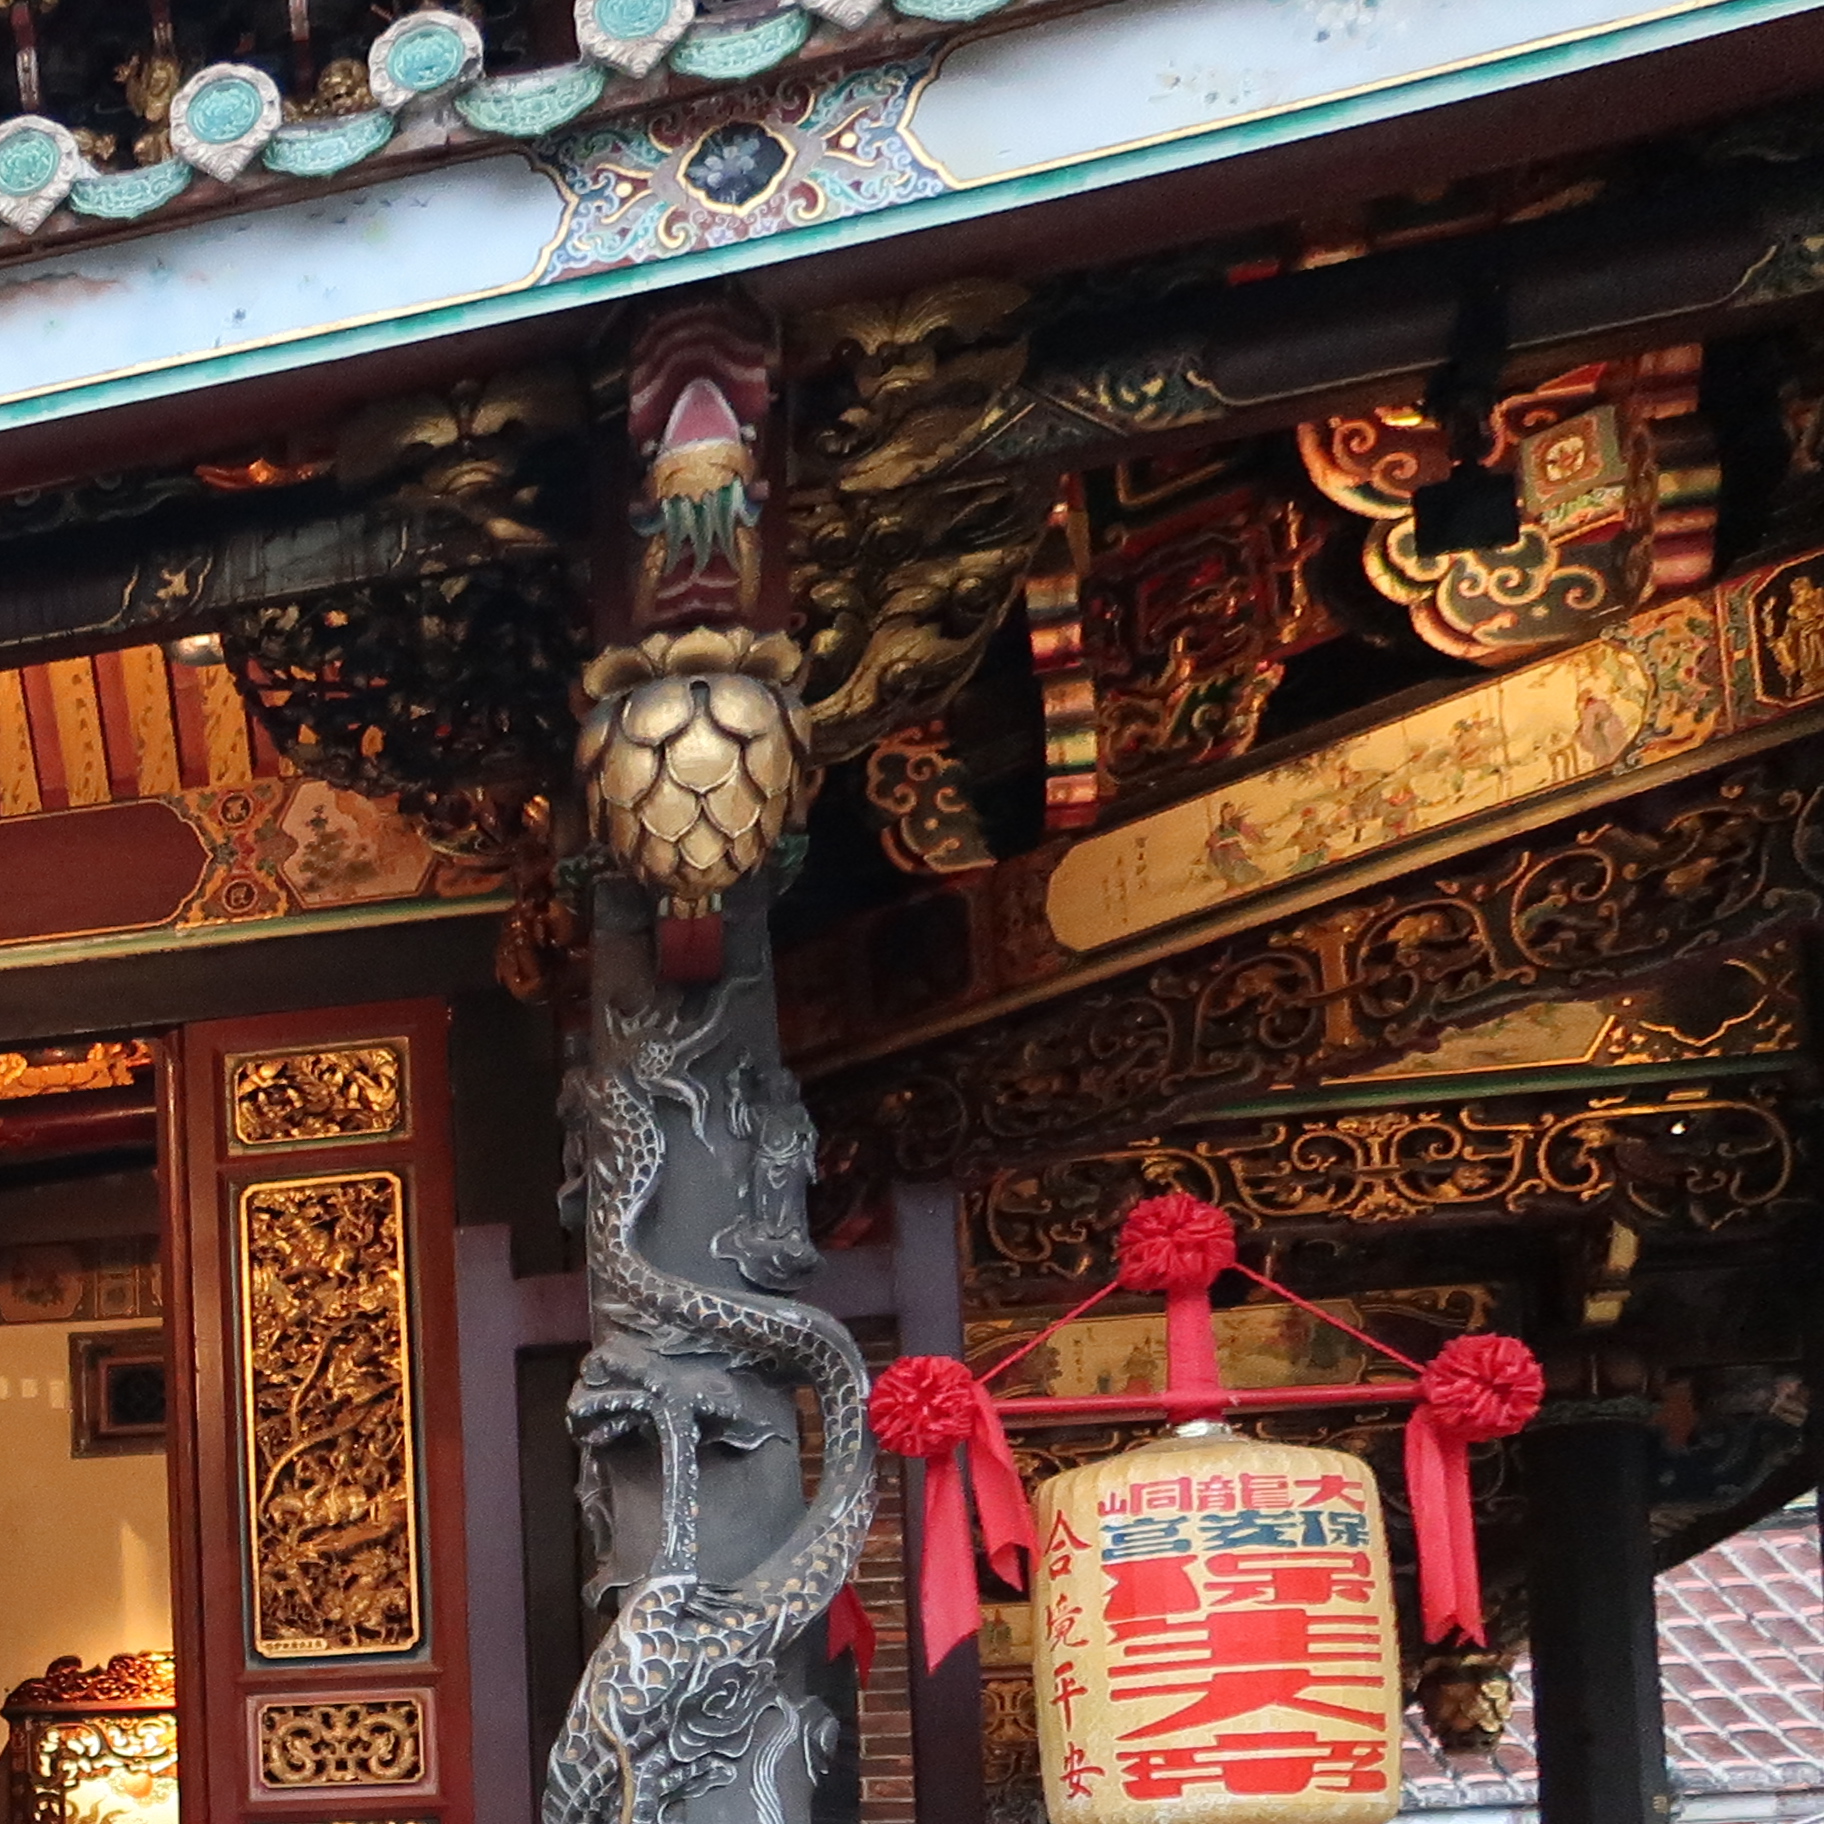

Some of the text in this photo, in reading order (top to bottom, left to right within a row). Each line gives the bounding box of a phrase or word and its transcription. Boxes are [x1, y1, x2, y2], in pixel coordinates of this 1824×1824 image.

[1100, 1510, 1370, 1561] 保安宮
[1044, 1509, 1104, 1798] 合境平安
